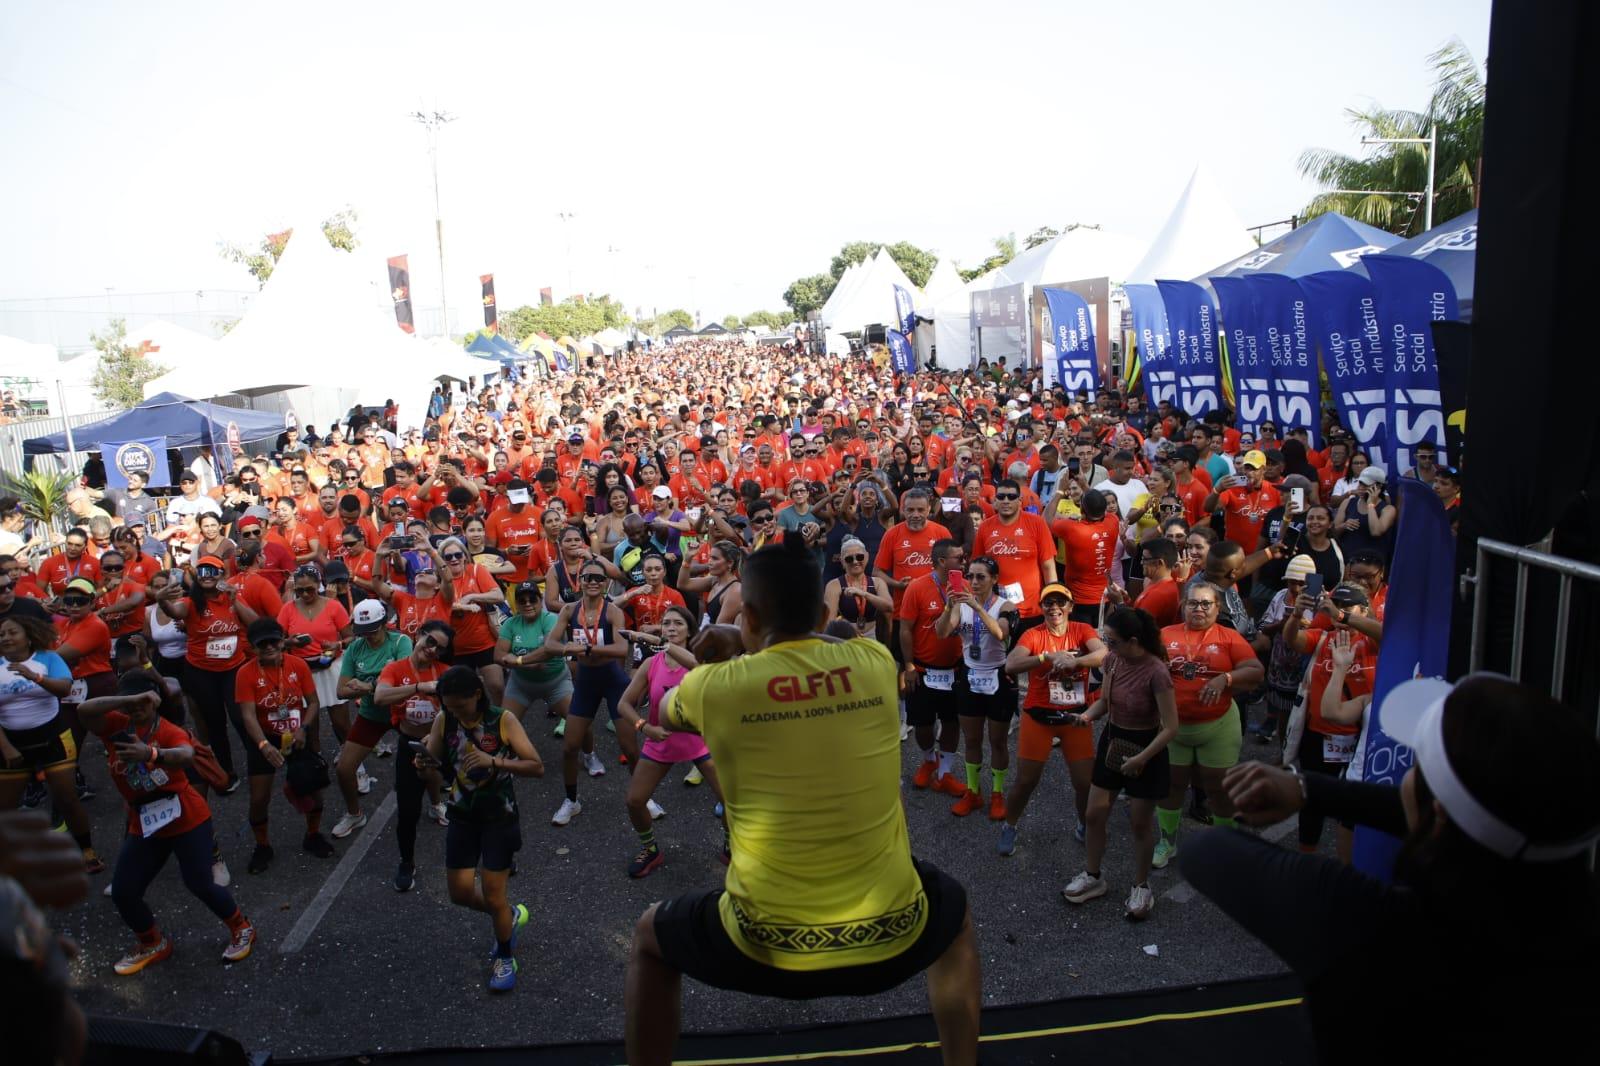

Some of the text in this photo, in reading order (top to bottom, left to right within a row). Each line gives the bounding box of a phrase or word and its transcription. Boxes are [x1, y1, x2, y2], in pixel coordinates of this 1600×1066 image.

[1200, 305, 1214, 364] da Indústria
[1292, 301, 1308, 367] da Indústria
[1360, 298, 1384, 354] Indústria
[1144, 329, 1156, 362] Serviço
[1178, 330, 1188, 365] Serviço
[1189, 335, 1200, 364] Social
[1234, 329, 1245, 366] Serviço
[1246, 335, 1258, 366] Social
[1268, 327, 1282, 366] Serviço
[1282, 334, 1292, 366] Social
[1330, 332, 1350, 378] Serviço
[1348, 338, 1367, 376] Social
[1392, 324, 1406, 372] Serviço
[1410, 333, 1426, 372] Social
[900, 552, 934, 565] Círi
[767, 666, 853, 703] GLFIT
[271, 720, 297, 730] 7510
[741, 696, 885, 724] ACADEMIA 100% PARAENSE
[143, 808, 174, 826] 8147
